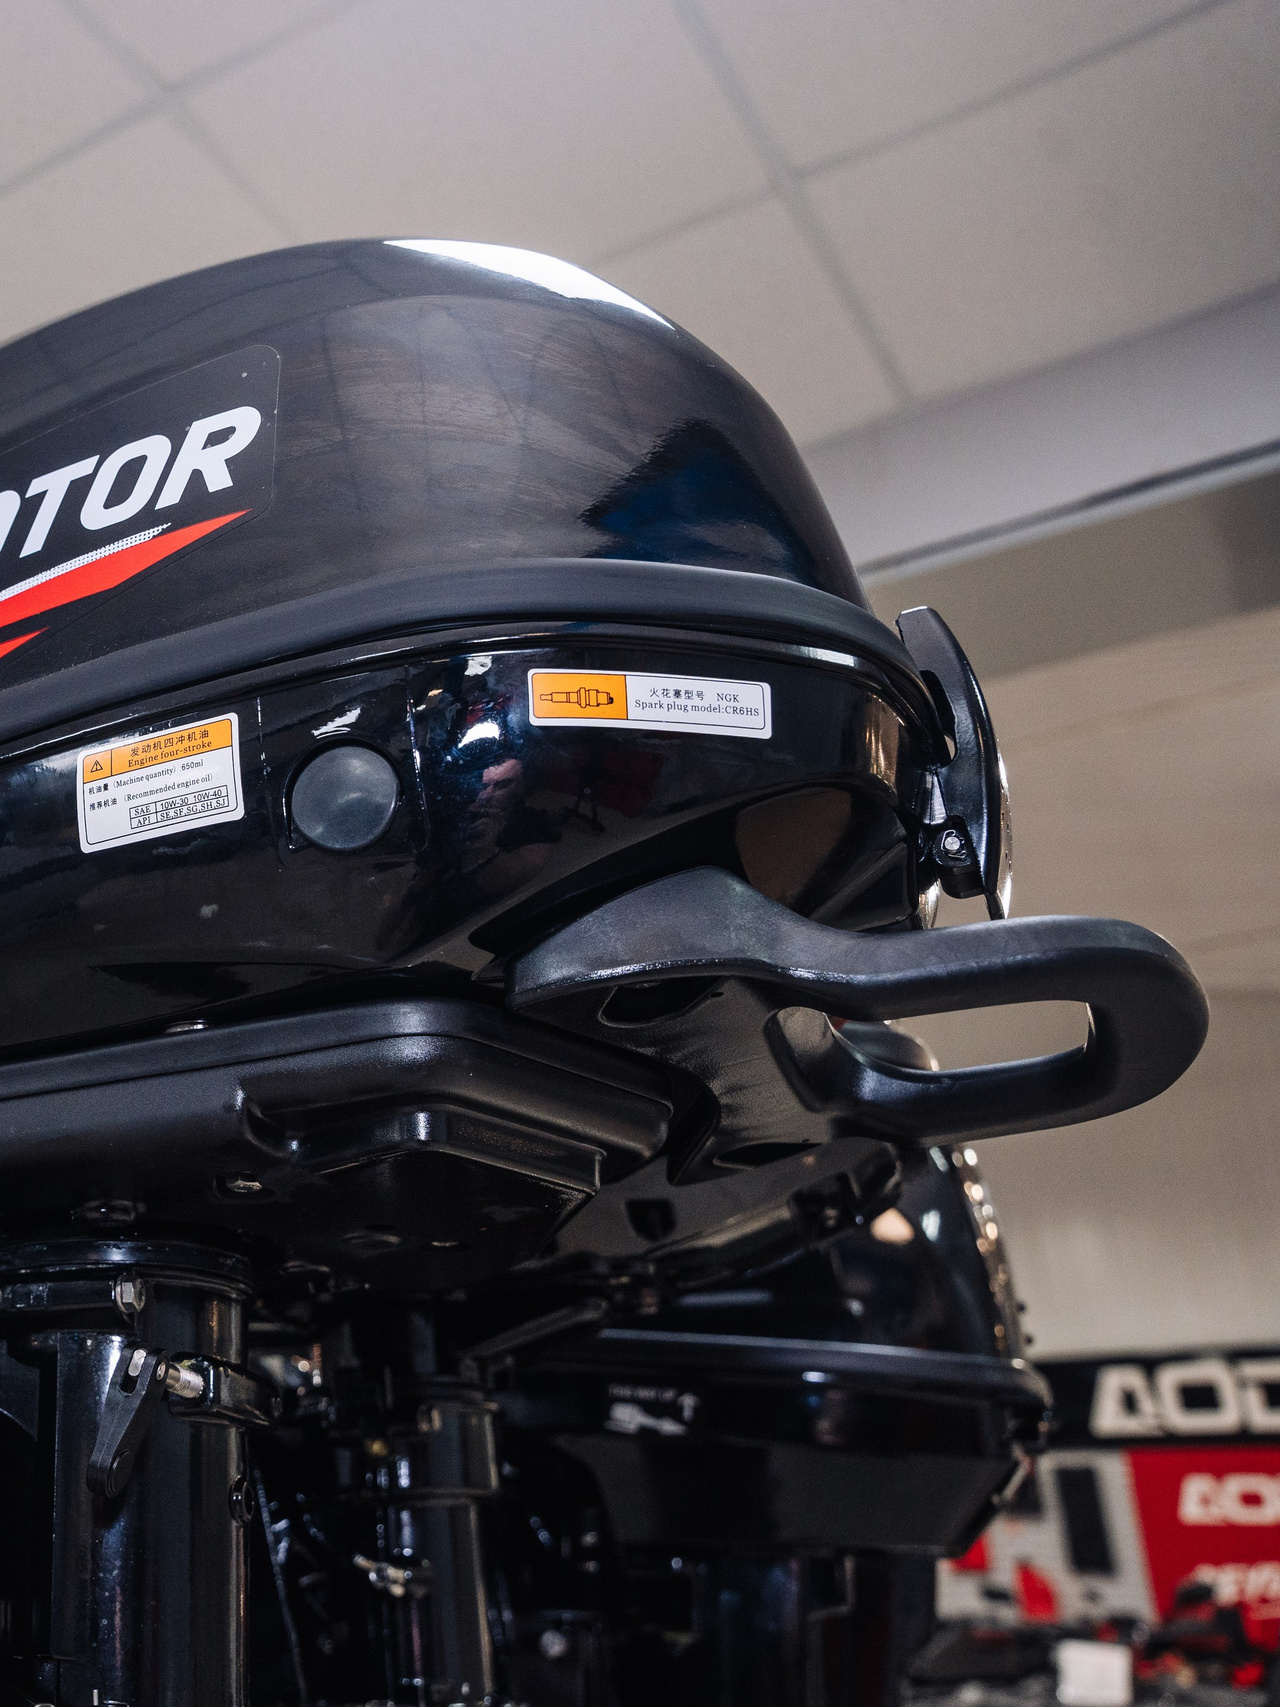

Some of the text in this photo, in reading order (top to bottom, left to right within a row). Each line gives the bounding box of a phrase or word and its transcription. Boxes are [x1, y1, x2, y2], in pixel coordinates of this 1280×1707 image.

[649, 687, 705, 701] 火花塞型号
[716, 692, 740, 703] NGK
[634, 699, 665, 712] Spark
[666, 702, 689, 714] plug
[130, 729, 209, 757] 发动机四冲机油
[128, 740, 212, 768] Engine four-stroke
[177, 777, 200, 788] engine
[134, 789, 223, 816] SAE 10W-30 10W-40
[136, 817, 151, 827] API
